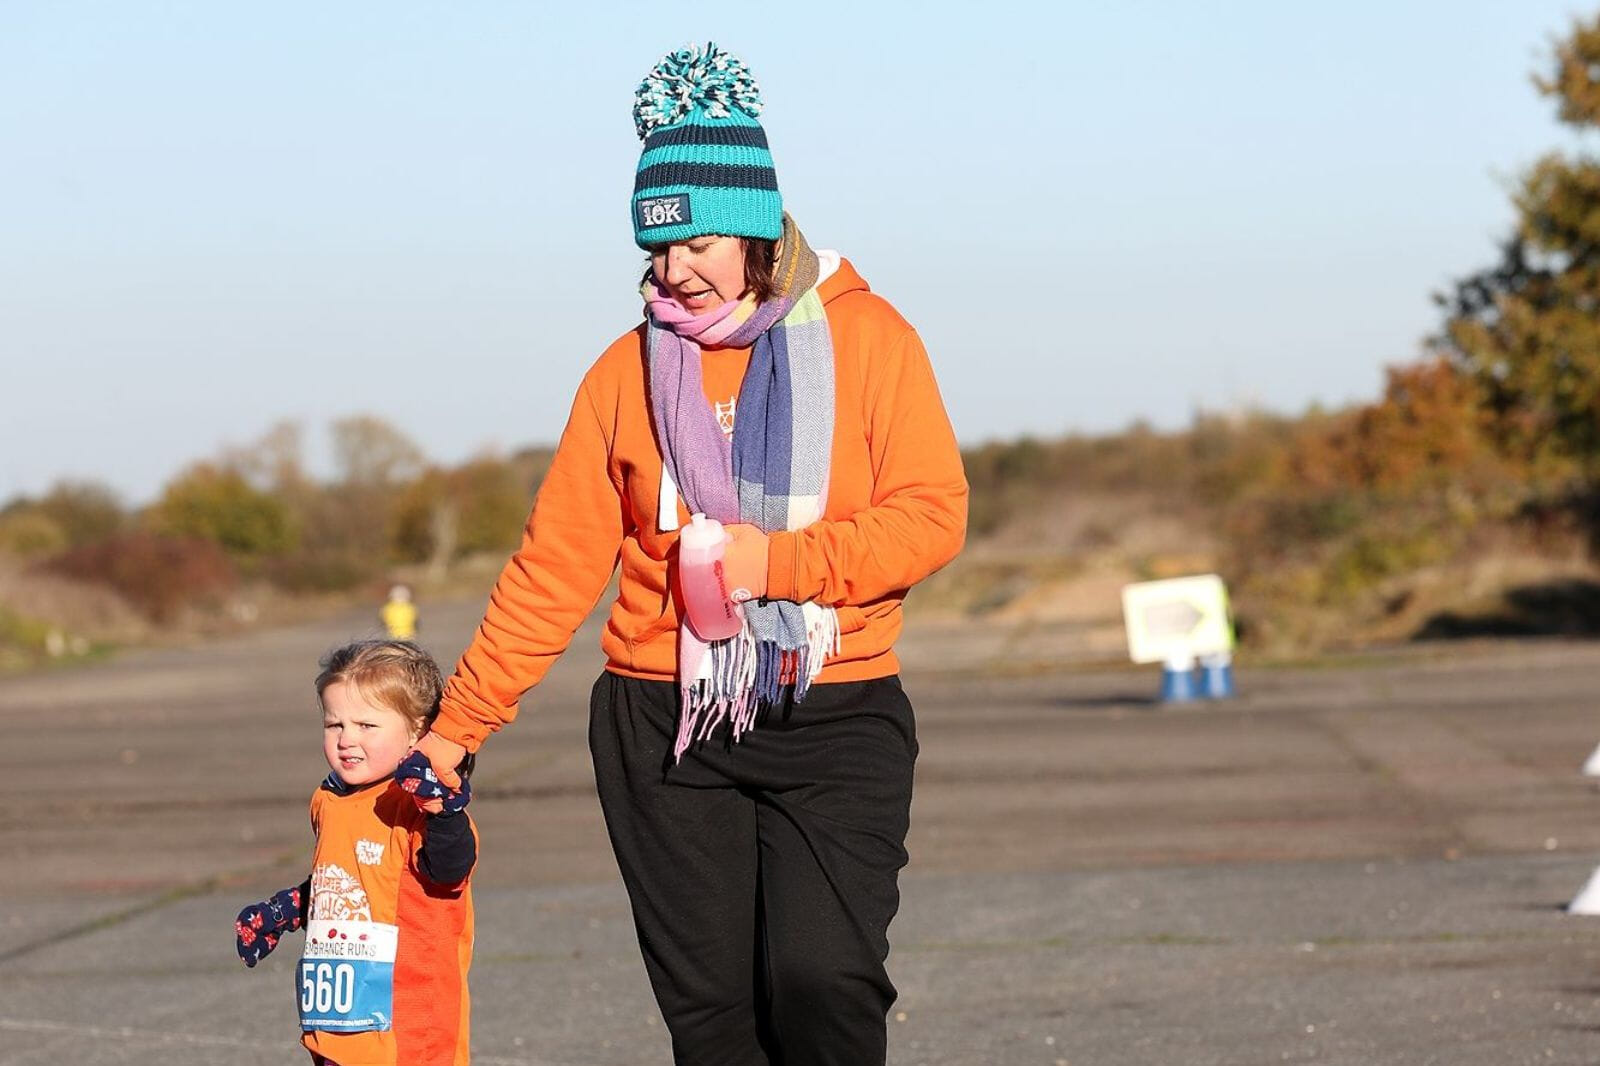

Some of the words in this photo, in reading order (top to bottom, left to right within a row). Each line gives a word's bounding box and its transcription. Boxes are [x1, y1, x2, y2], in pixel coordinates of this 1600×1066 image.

[644, 203, 682, 226] 10K
[347, 943, 377, 957] RUNS
[302, 963, 355, 1013] 560
